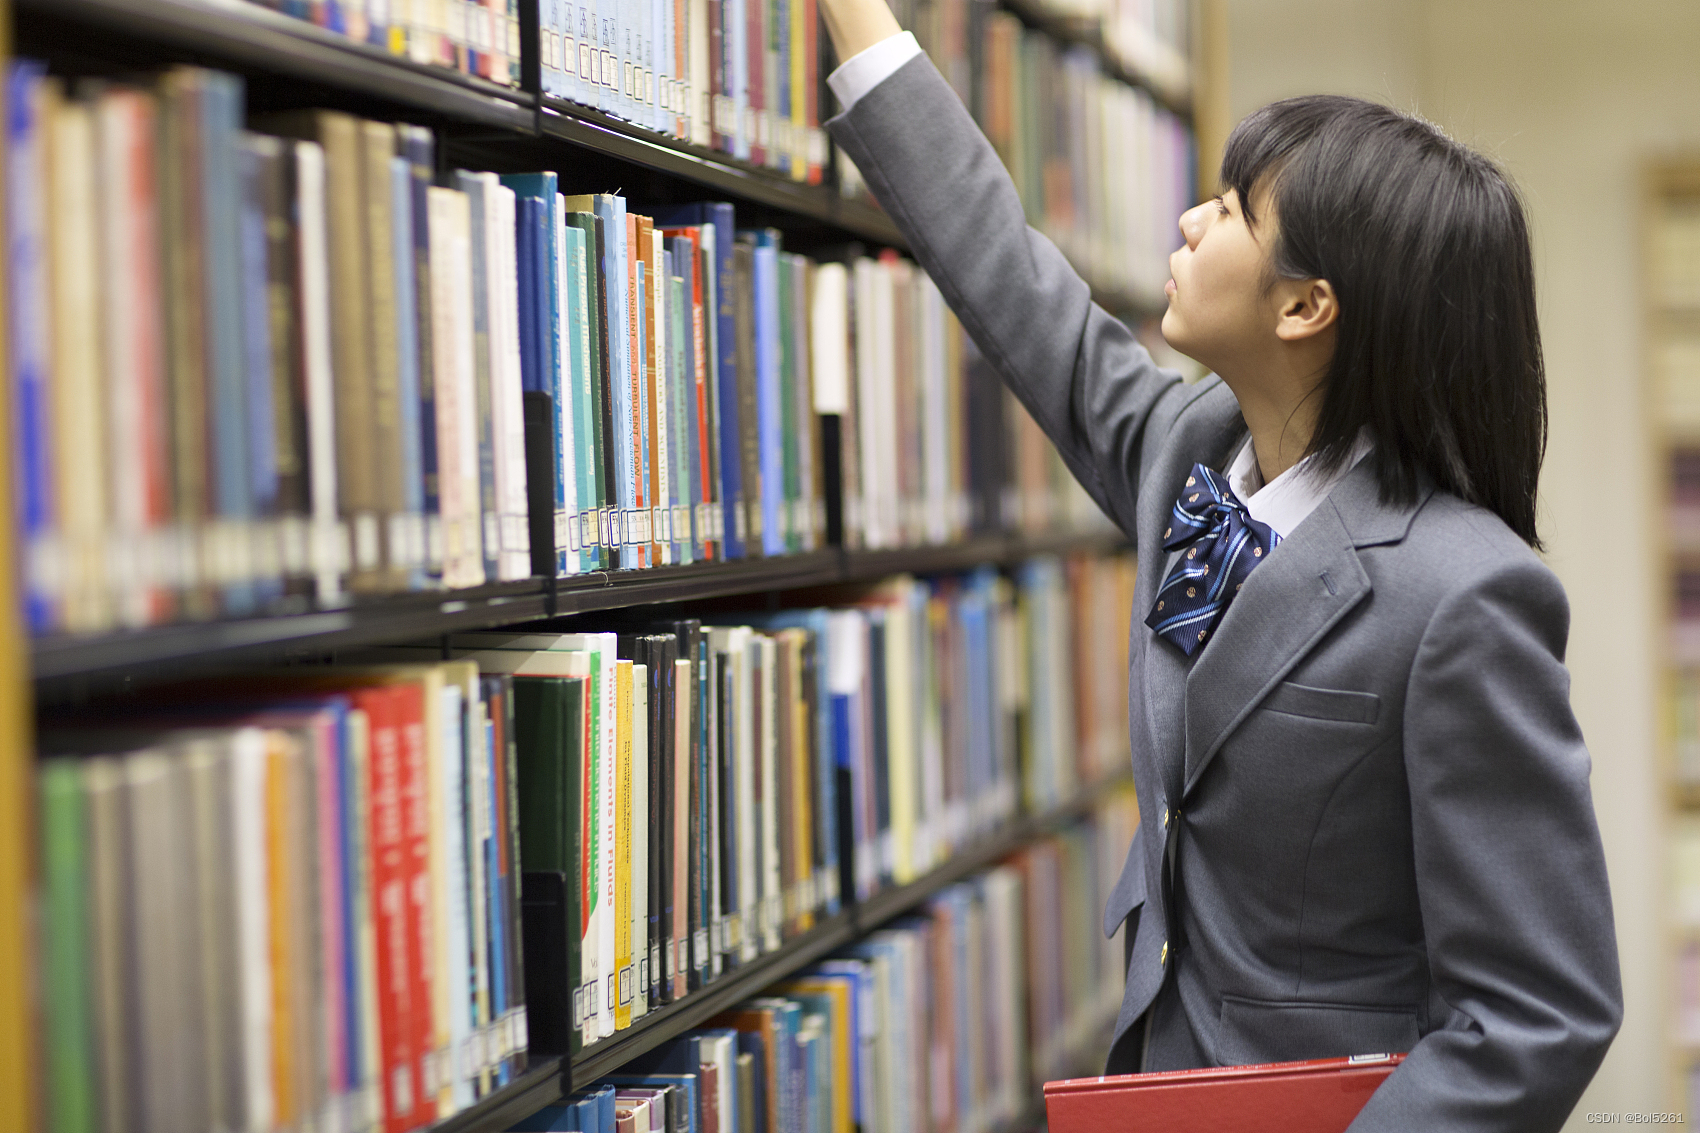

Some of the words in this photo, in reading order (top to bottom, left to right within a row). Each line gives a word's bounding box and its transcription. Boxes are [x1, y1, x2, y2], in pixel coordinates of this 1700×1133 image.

[579, 246, 587, 274] Fluid
[580, 275, 588, 322] Pressure
[582, 324, 591, 395] Mechanisms
